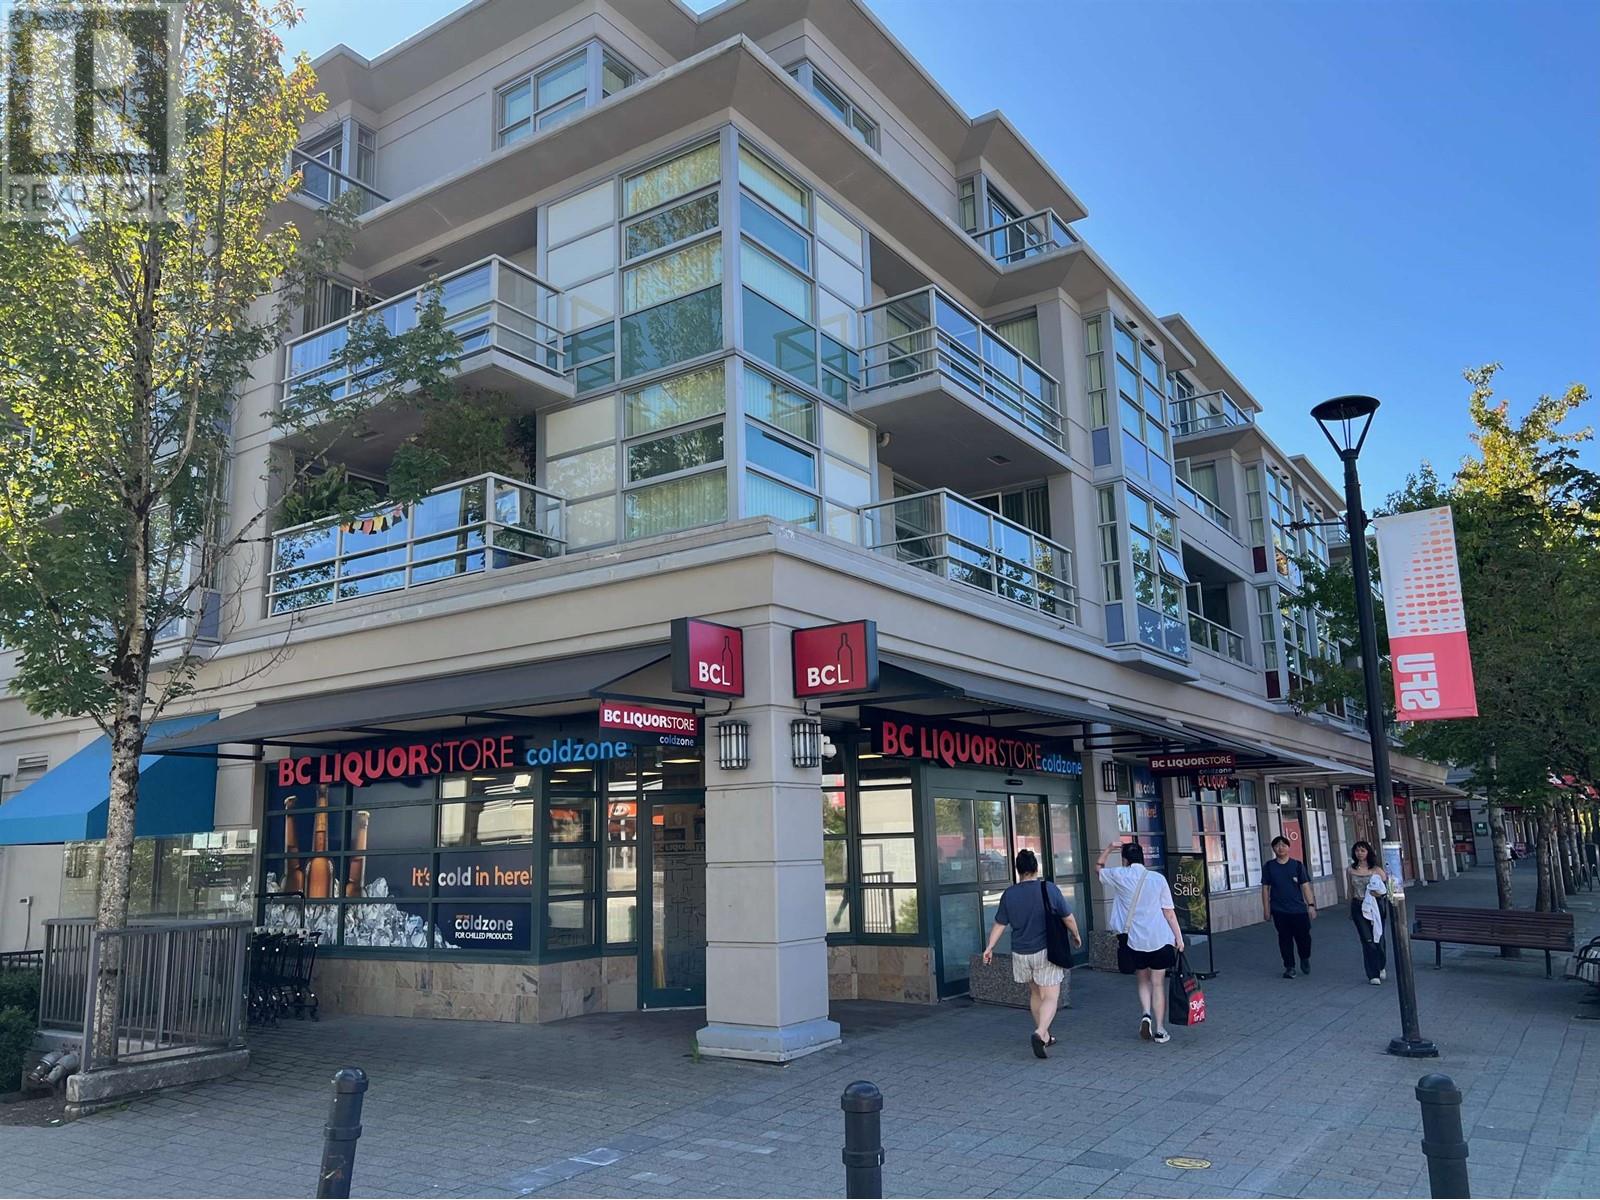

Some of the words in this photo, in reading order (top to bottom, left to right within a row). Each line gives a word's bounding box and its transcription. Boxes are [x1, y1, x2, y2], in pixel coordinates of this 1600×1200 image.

[698, 661, 731, 687] BCL
[807, 663, 850, 688] BCL
[604, 709, 621, 723] BC
[659, 735, 694, 747] coldzone
[882, 721, 914, 758] BC
[526, 736, 628, 766] coldzone
[278, 757, 312, 787] BC
[1042, 755, 1083, 776] coldzone
[1151, 760, 1165, 768] BC
[412, 866, 431, 887] It's
[437, 865, 472, 887] cold
[475, 865, 489, 886] in
[494, 864, 533, 886] here!
[1175, 873, 1197, 883] Flash
[1173, 882, 1200, 897] Sale
[454, 914, 514, 931] coldzone
[454, 931, 466, 939] FOR
[465, 931, 486, 940] CHILLED
[485, 932, 513, 940] PRODUCTS
